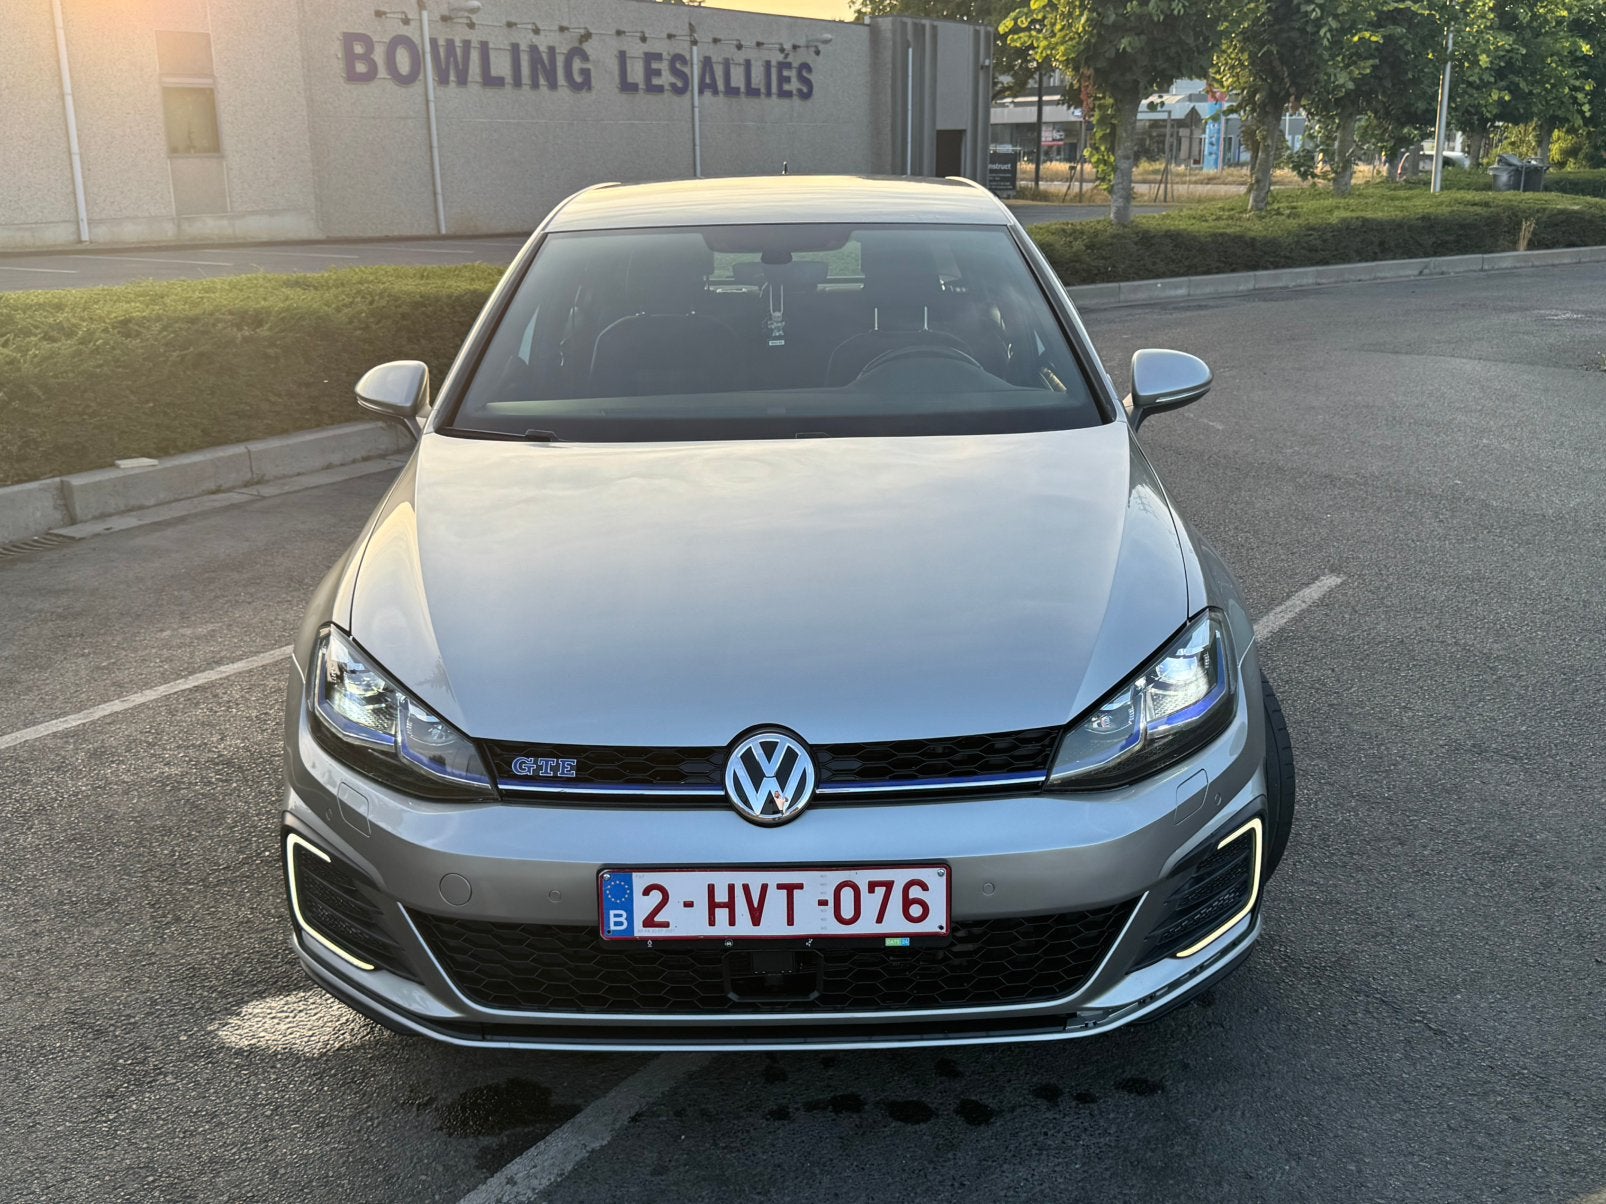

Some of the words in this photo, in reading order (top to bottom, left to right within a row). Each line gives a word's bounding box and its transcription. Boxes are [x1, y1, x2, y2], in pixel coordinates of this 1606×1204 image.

[342, 32, 592, 91] BOWLING
[618, 50, 690, 95] LES
[699, 52, 814, 99] ALLIÉS
[511, 757, 577, 777] GTE
[609, 910, 628, 930] B
[642, 879, 930, 929] 2-HVT-076
